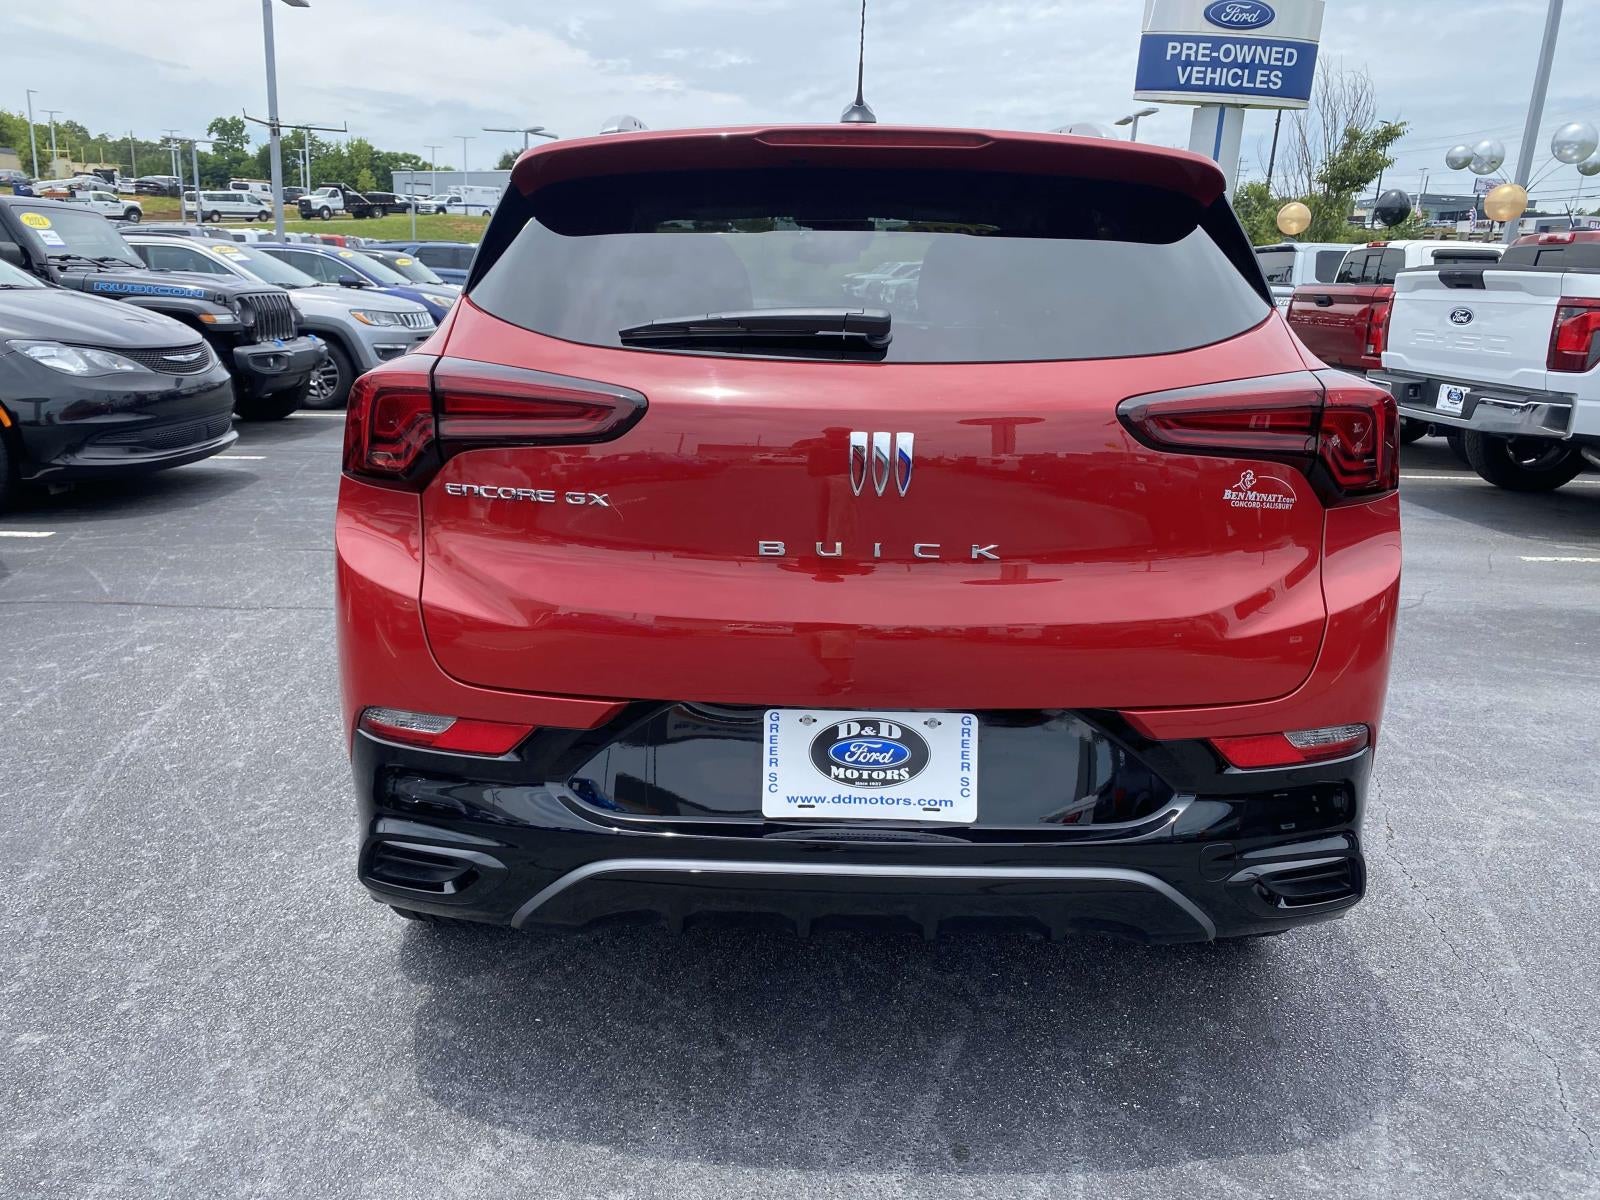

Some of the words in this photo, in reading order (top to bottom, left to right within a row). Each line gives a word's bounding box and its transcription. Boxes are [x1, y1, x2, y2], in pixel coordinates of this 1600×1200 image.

[1220, 3, 1260, 23] Ford
[1166, 41, 1298, 67] PRE-OWNED
[1176, 66, 1283, 90] VEHICLES
[93, 281, 205, 298] RUBICON
[1451, 309, 1472, 323] Ford
[445, 482, 556, 503] ENCORE
[565, 491, 609, 507] GX
[758, 540, 1001, 560] BUICK
[769, 711, 780, 768] GREER
[836, 720, 902, 740] D&D
[844, 742, 895, 764] Ford
[960, 715, 972, 772] GREER
[768, 772, 779, 793] SC
[830, 765, 911, 781] MOTORS
[960, 776, 971, 798] SC
[786, 794, 954, 808] www.ddmotors.com
